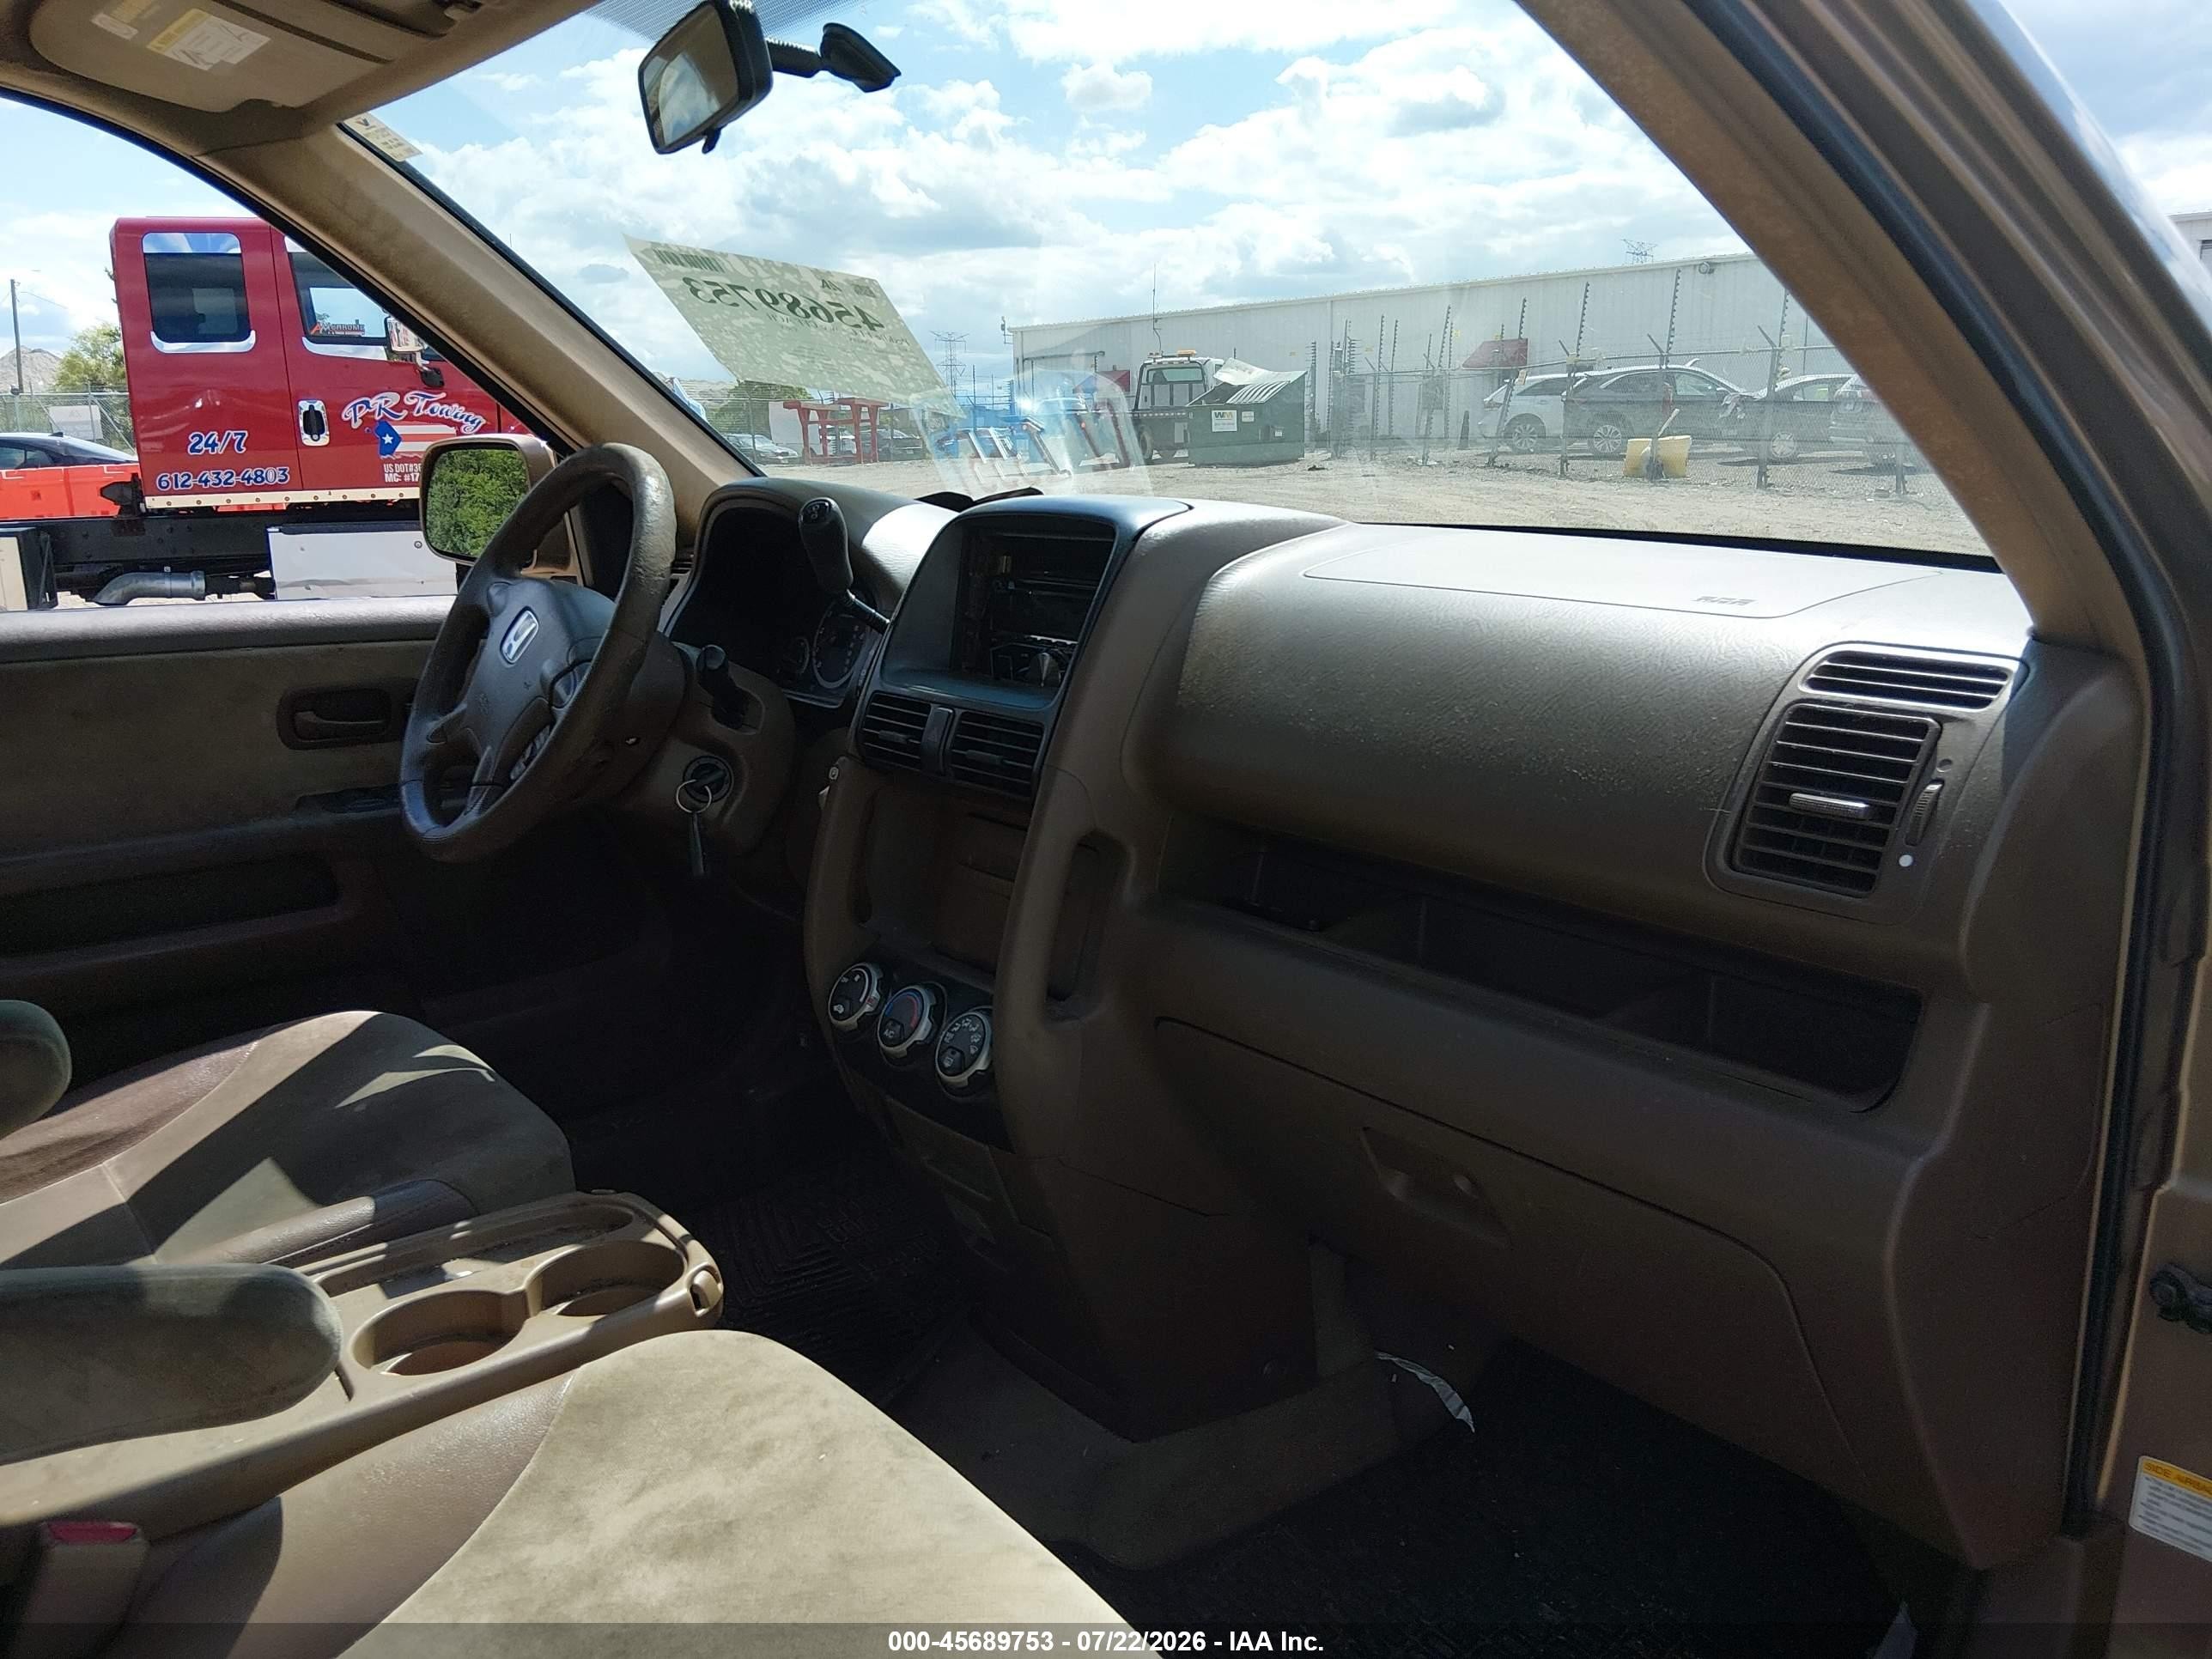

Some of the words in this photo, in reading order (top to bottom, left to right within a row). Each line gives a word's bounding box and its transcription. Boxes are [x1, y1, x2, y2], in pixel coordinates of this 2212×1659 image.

[341, 392, 408, 429] PR
[404, 390, 486, 434] Towing
[188, 430, 248, 455] 24/7
[156, 466, 289, 490] 612-432-4803
[383, 463, 394, 473] US
[385, 473, 402, 483] MC:
